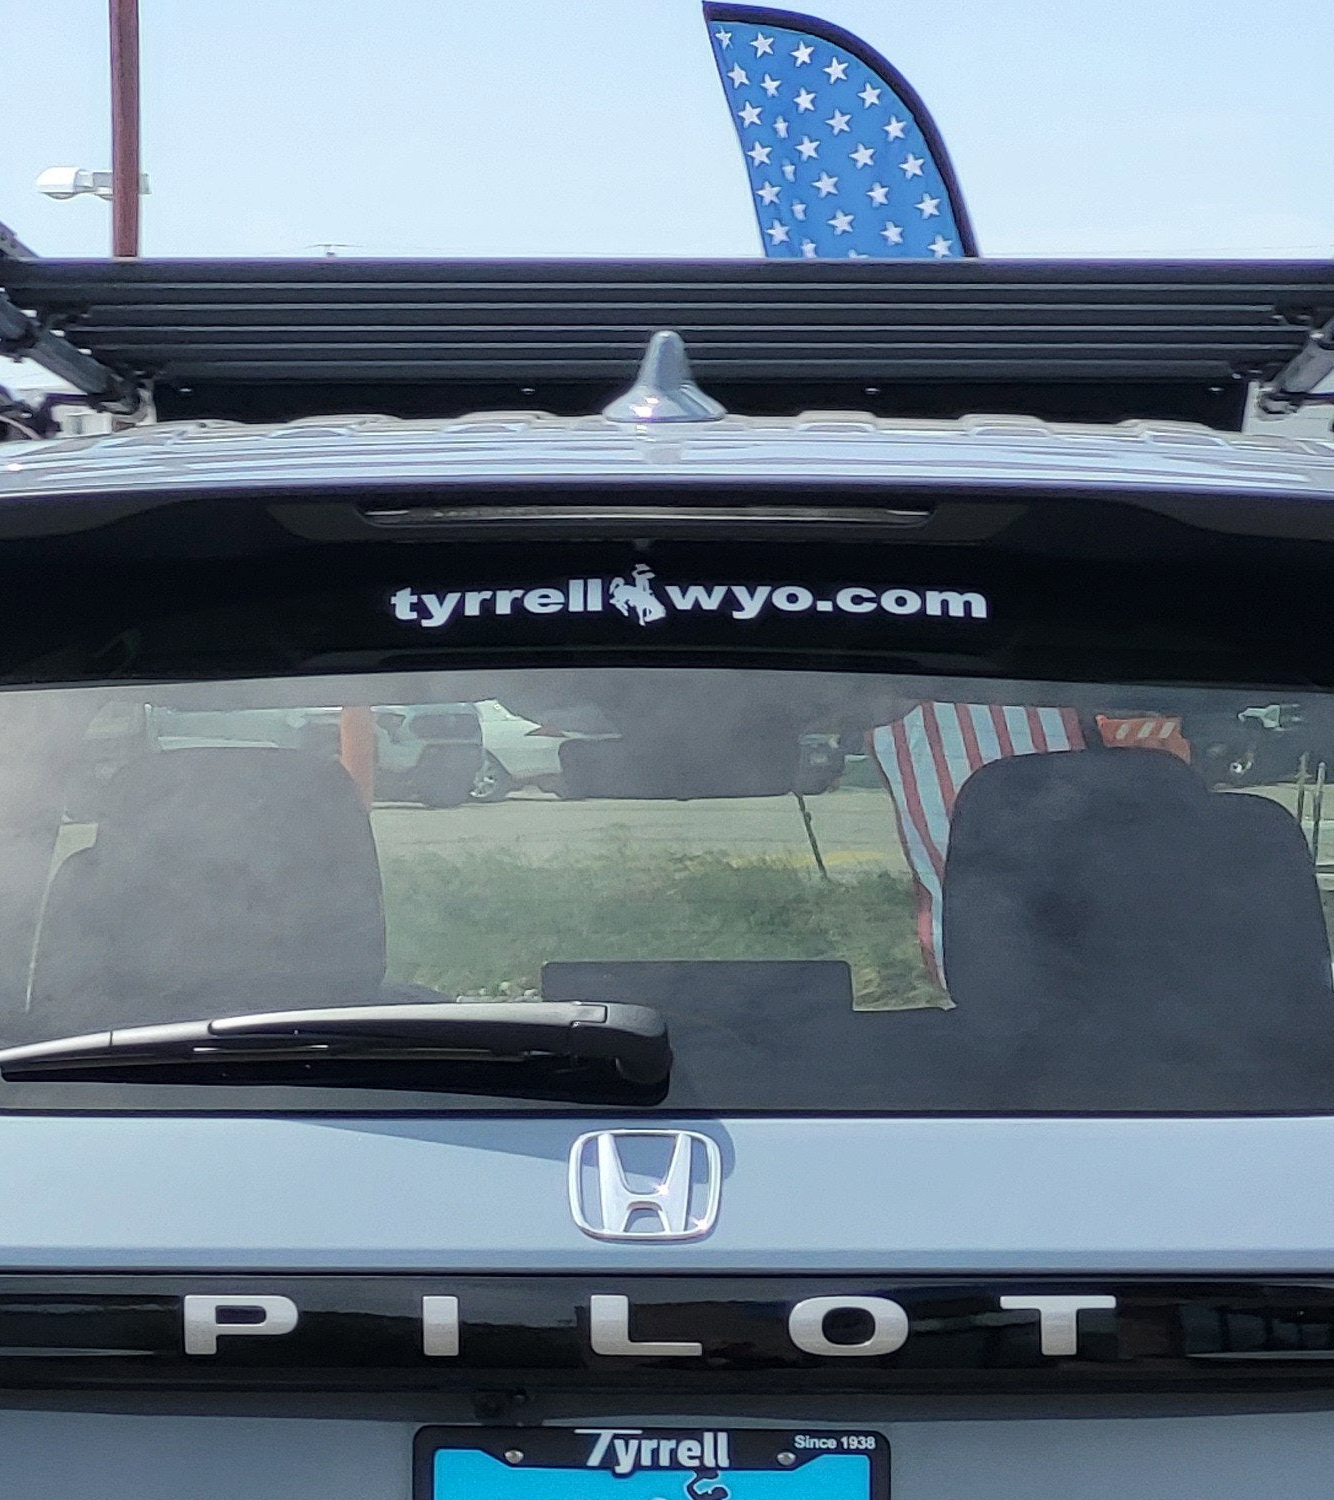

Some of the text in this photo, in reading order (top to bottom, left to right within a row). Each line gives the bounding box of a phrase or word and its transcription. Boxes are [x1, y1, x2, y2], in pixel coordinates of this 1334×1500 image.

[183, 1294, 1116, 1357] PILOT
[574, 1428, 731, 1474] Tyrrell
[794, 1434, 876, 1451] Since 1938
